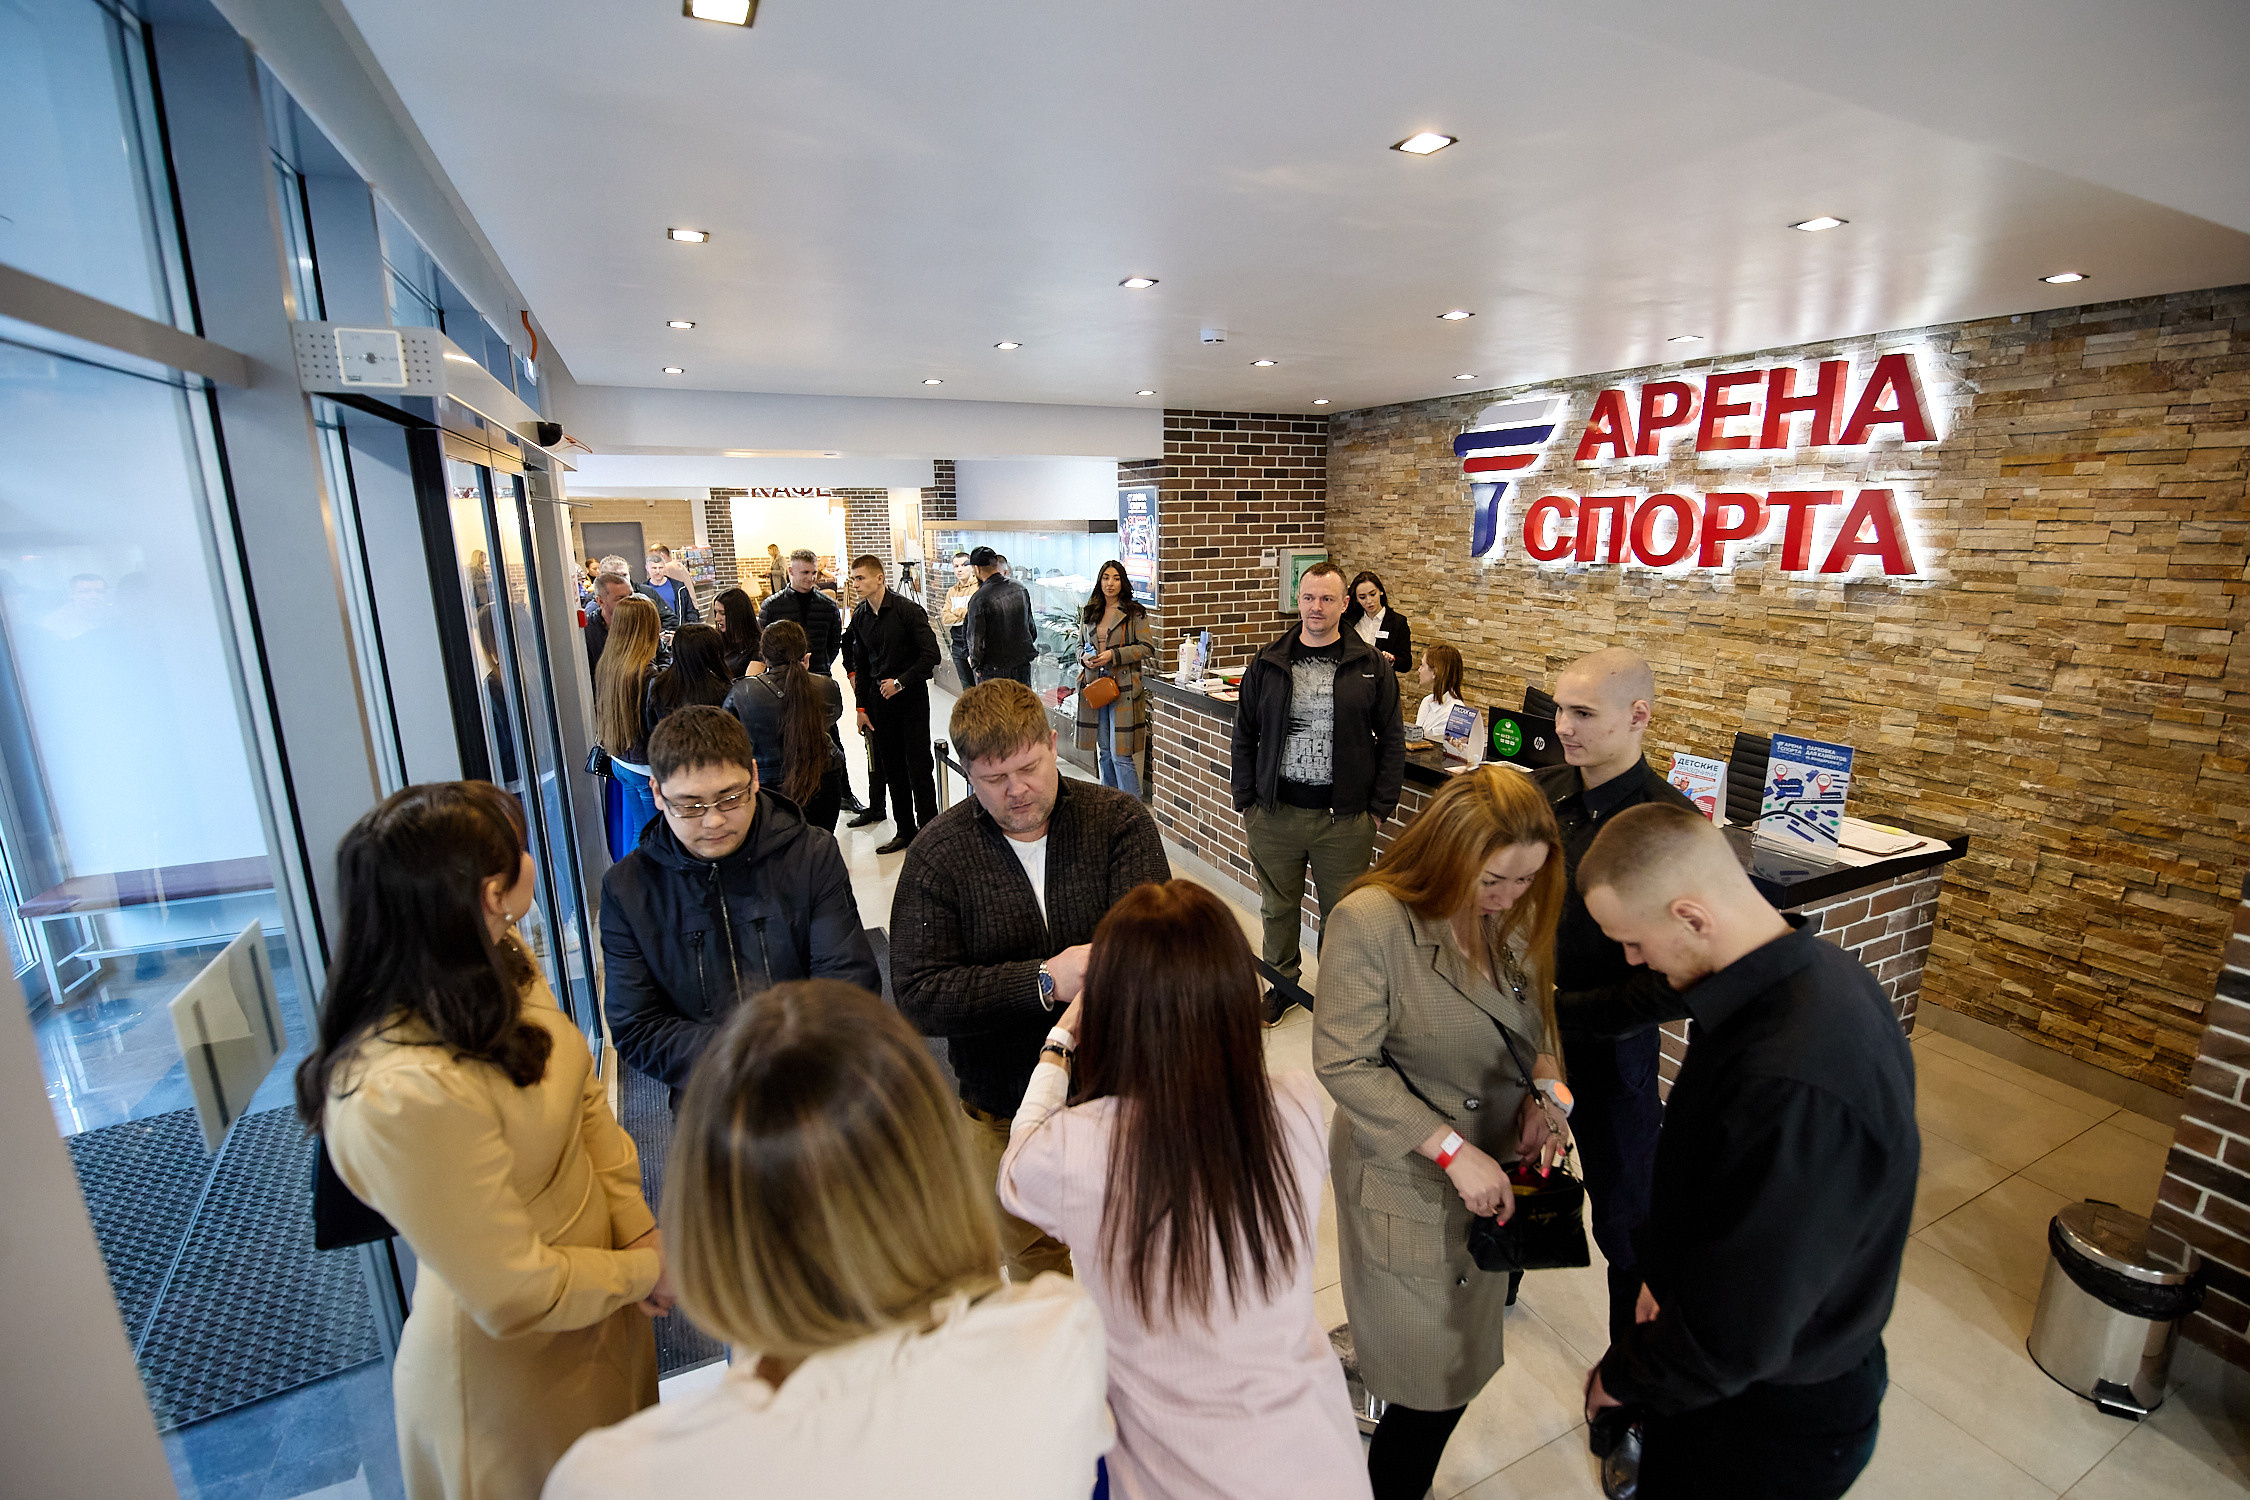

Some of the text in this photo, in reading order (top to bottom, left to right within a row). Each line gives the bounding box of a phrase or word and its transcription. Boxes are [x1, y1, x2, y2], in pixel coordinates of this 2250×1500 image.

[1573, 353, 1938, 461] АРЕНА
[1523, 488, 1917, 575] СПОРТА
[1780, 746, 1802, 754] СПОРТА
[1783, 742, 1803, 750] АРЕНА
[1806, 745, 1836, 755] ПАРКОВКА
[1817, 752, 1847, 762] КЛИЕНТОВ
[1677, 757, 1719, 772] ДЕТСКИЕ
[1675, 764, 1717, 778] ПРАЗДНИКИ
